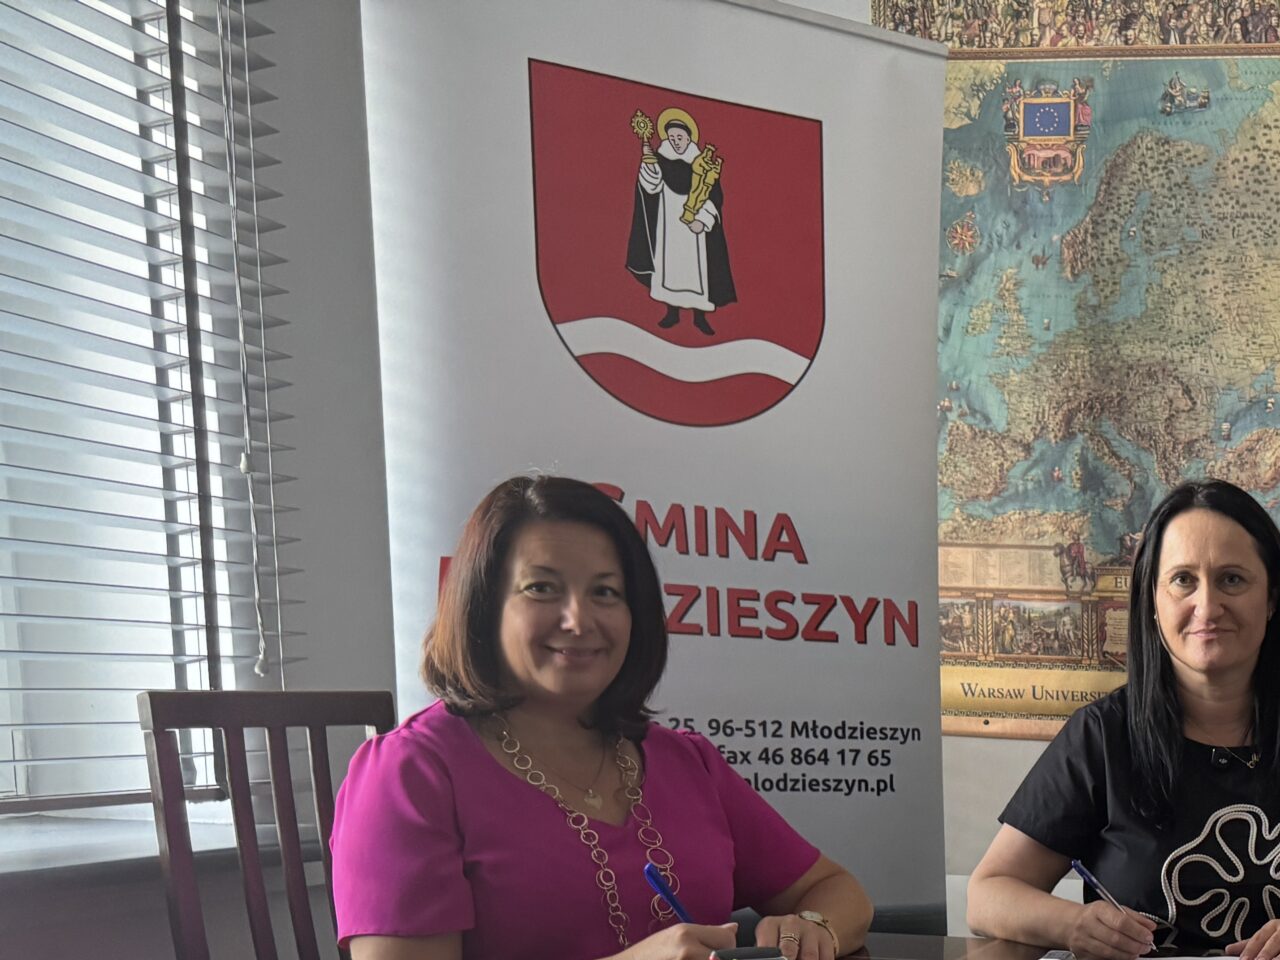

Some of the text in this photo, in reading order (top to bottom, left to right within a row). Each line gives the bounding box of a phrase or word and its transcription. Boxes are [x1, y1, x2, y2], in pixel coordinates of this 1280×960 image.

[593, 482, 808, 564] MINA
[708, 718, 783, 738] 96-512
[790, 720, 921, 745] Młodzieszyn
[758, 747, 784, 765] 46
[790, 748, 829, 766] 864
[837, 749, 860, 766] 17
[867, 749, 891, 766] 65
